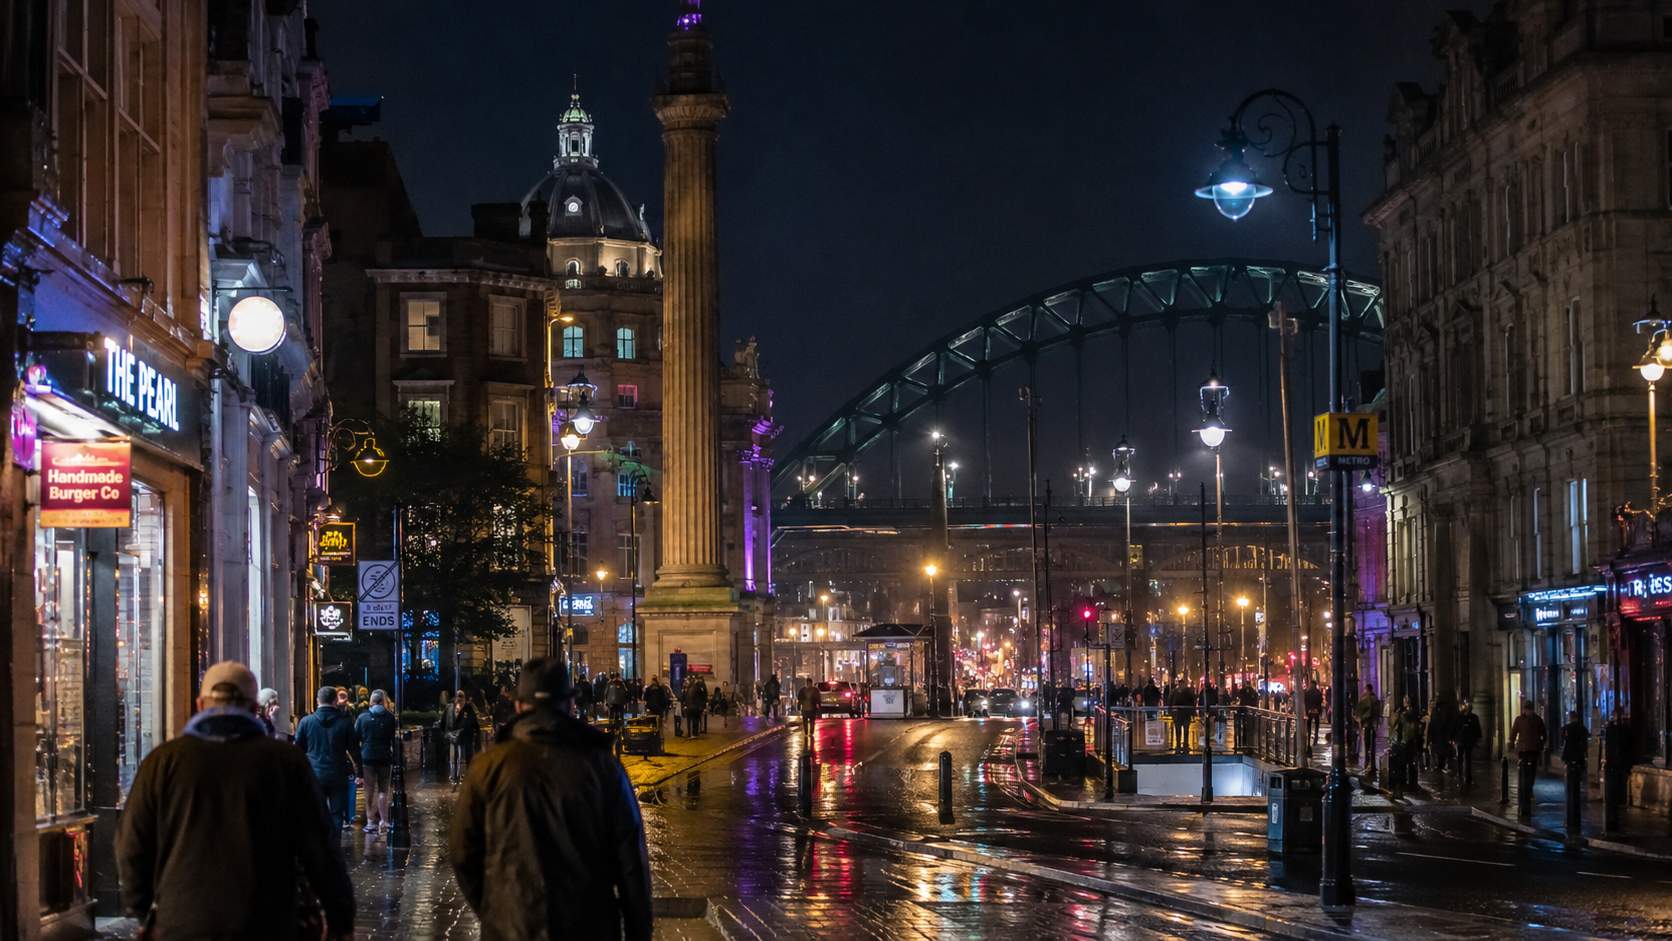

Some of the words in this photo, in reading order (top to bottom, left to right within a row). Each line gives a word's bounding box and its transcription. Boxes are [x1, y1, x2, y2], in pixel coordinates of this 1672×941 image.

[104, 337, 135, 406] THE
[138, 360, 180, 432] PEARL
[1337, 418, 1370, 449] M
[1338, 456, 1370, 465] METRO
[48, 469, 124, 483] Handmade
[49, 486, 99, 503] Burger
[100, 485, 120, 500] Co
[363, 615, 395, 626] ENDS
